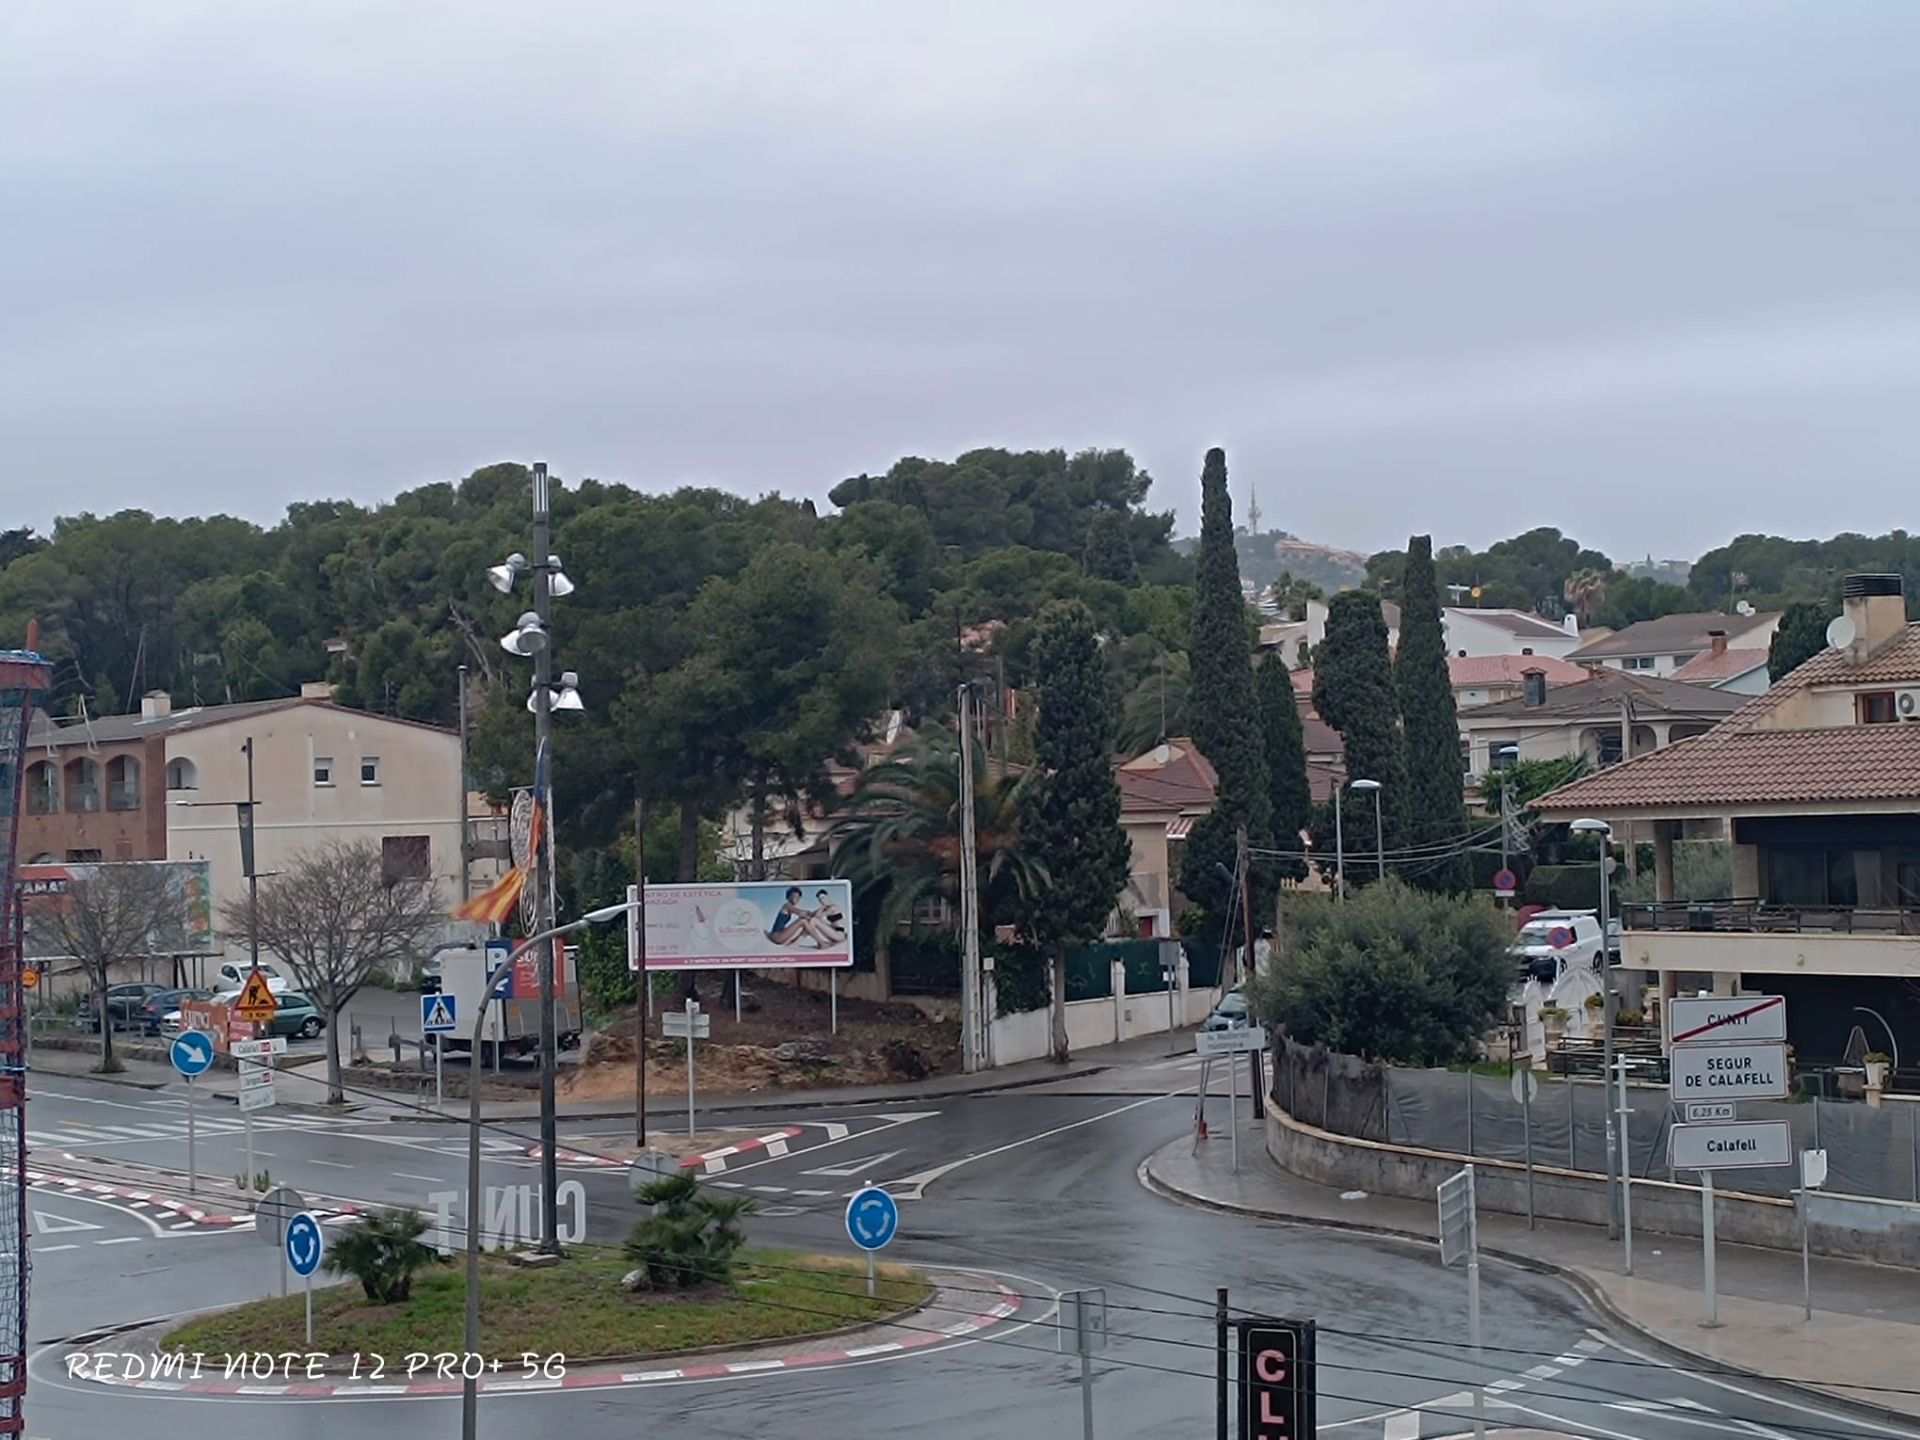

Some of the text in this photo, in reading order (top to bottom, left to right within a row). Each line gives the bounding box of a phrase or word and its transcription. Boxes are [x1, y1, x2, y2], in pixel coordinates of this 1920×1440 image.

[487, 947, 508, 973] P
[1707, 1057, 1752, 1071] SEGUR
[1685, 1073, 1774, 1088] DE CALAFELL
[1707, 1139, 1757, 1153] Calafell
[1256, 1349, 1286, 1440] CL
